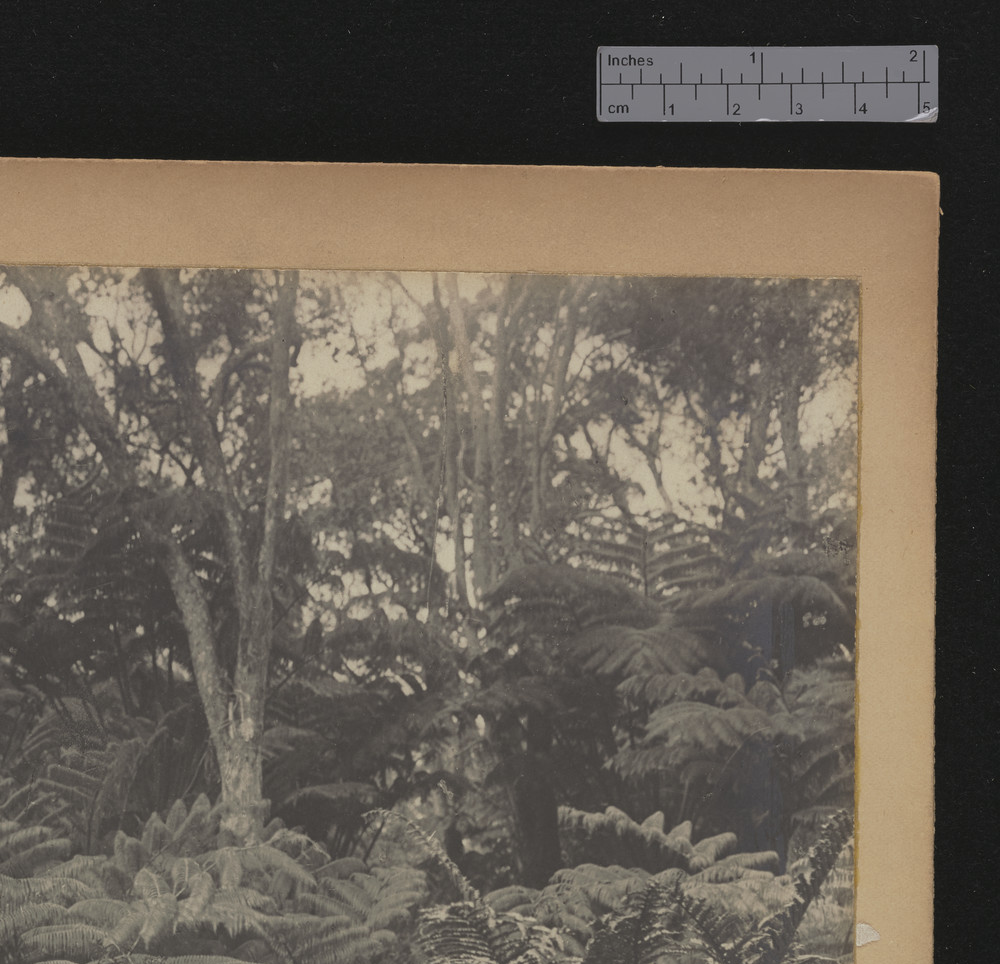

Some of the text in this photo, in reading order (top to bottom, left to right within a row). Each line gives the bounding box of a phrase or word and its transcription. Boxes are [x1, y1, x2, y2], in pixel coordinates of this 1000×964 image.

[607, 50, 918, 67] Inches 1 2
[608, 102, 931, 115] cm 1 2 3 4 5
